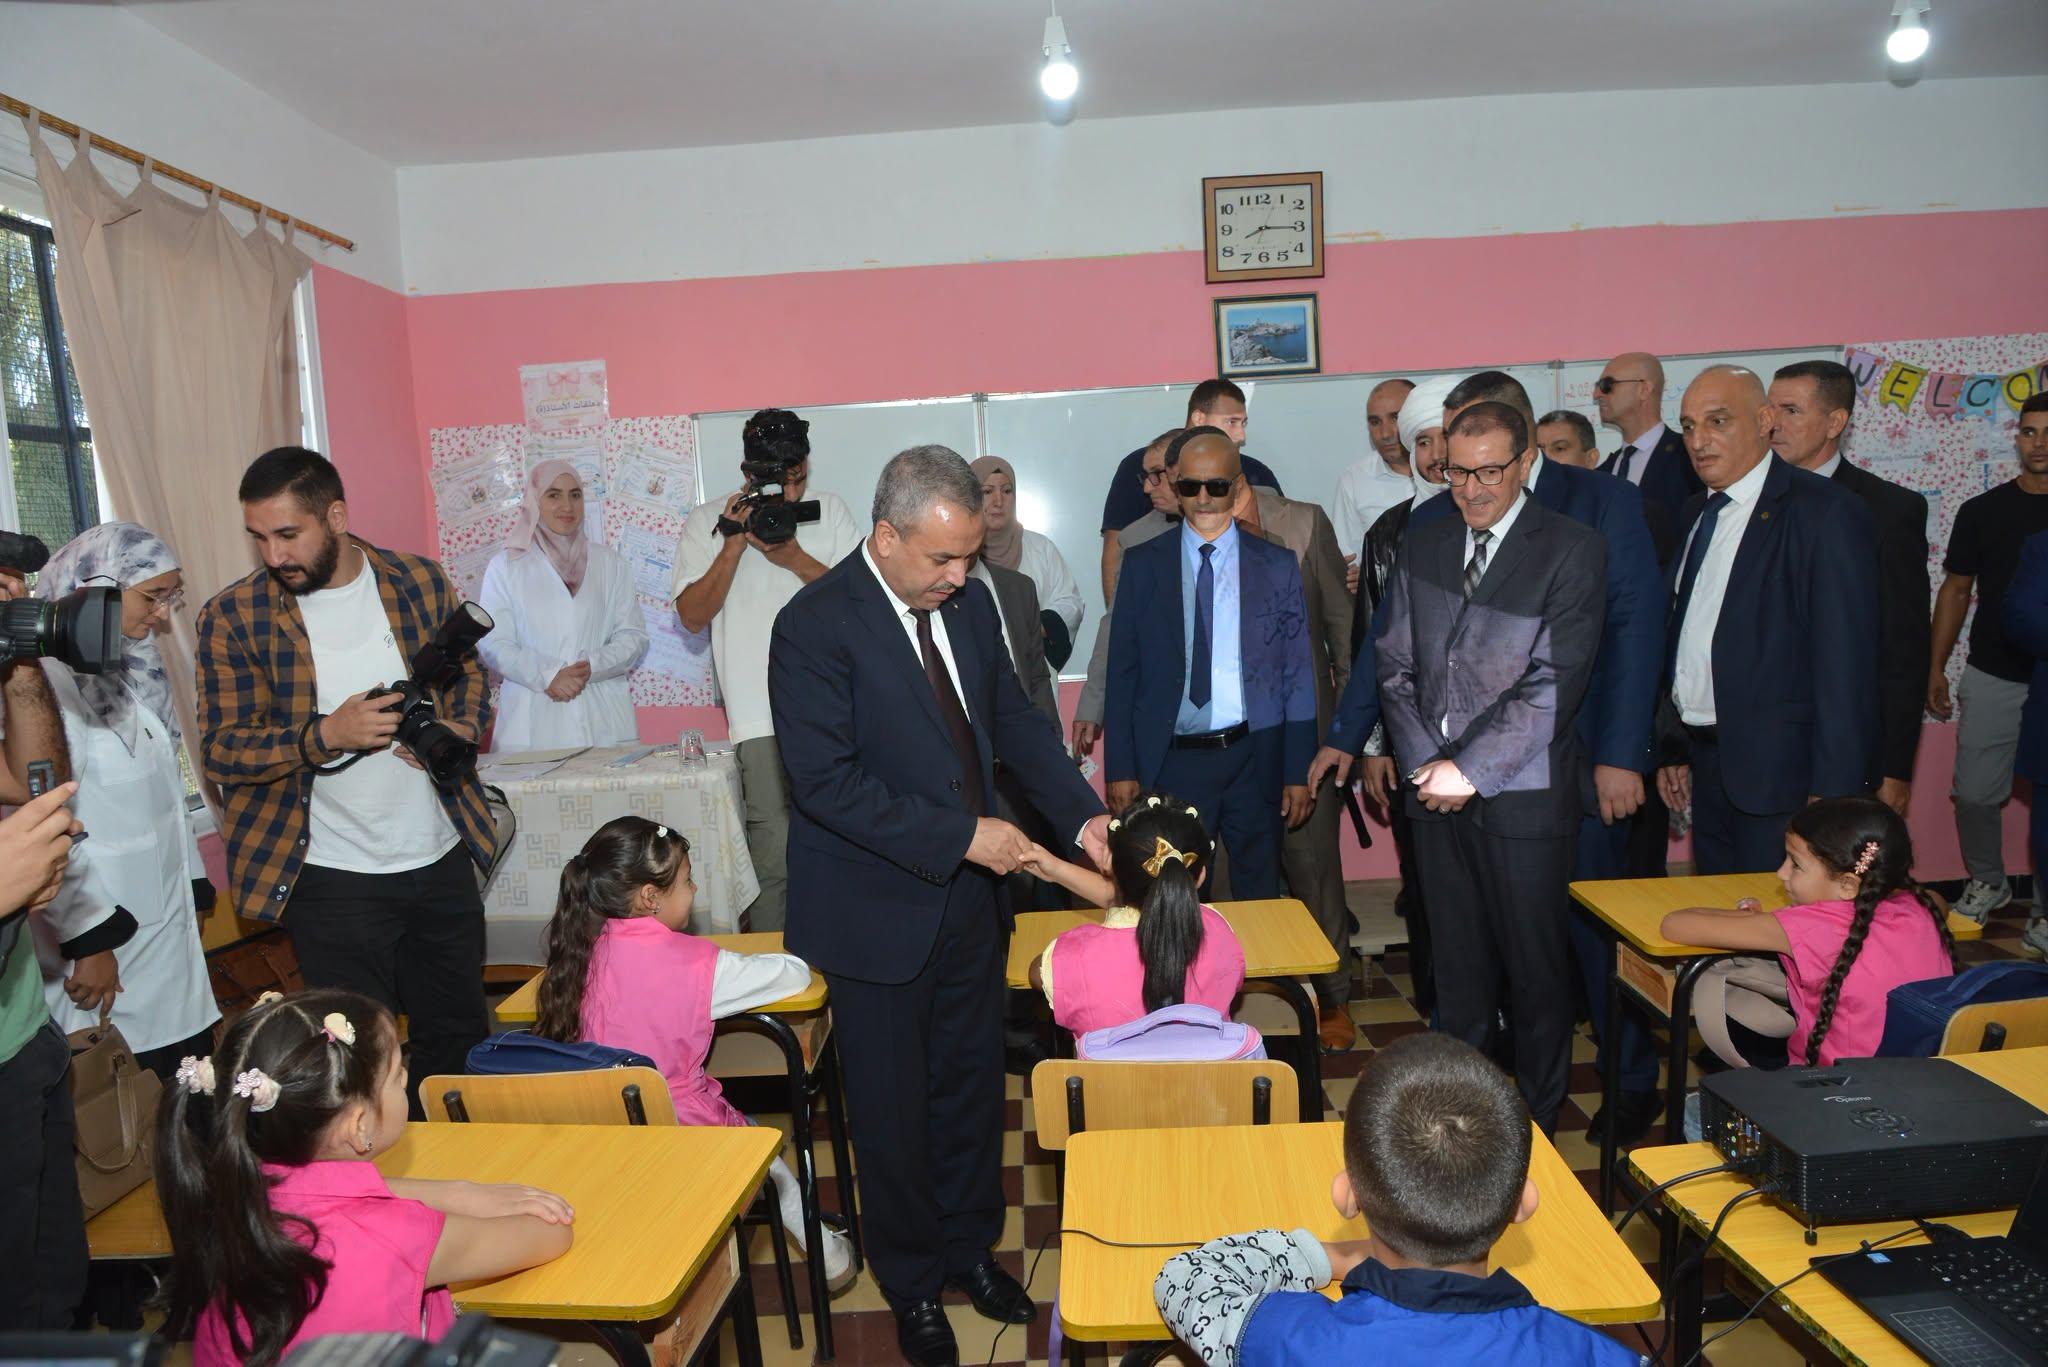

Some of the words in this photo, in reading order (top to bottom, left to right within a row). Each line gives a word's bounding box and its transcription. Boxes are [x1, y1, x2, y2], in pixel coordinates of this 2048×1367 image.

[1239, 195, 1251, 206] 11
[1254, 193, 1272, 205] 12
[1279, 193, 1285, 205] 1
[1292, 199, 1305, 211] 2
[1220, 203, 1234, 216] 10
[1220, 224, 1233, 236] 9
[1293, 220, 1306, 233] 3
[1222, 245, 1235, 258] 8
[1293, 242, 1305, 254] 4
[1241, 252, 1252, 264] 7
[1258, 251, 1270, 263] 6
[1277, 250, 1289, 262] 5
